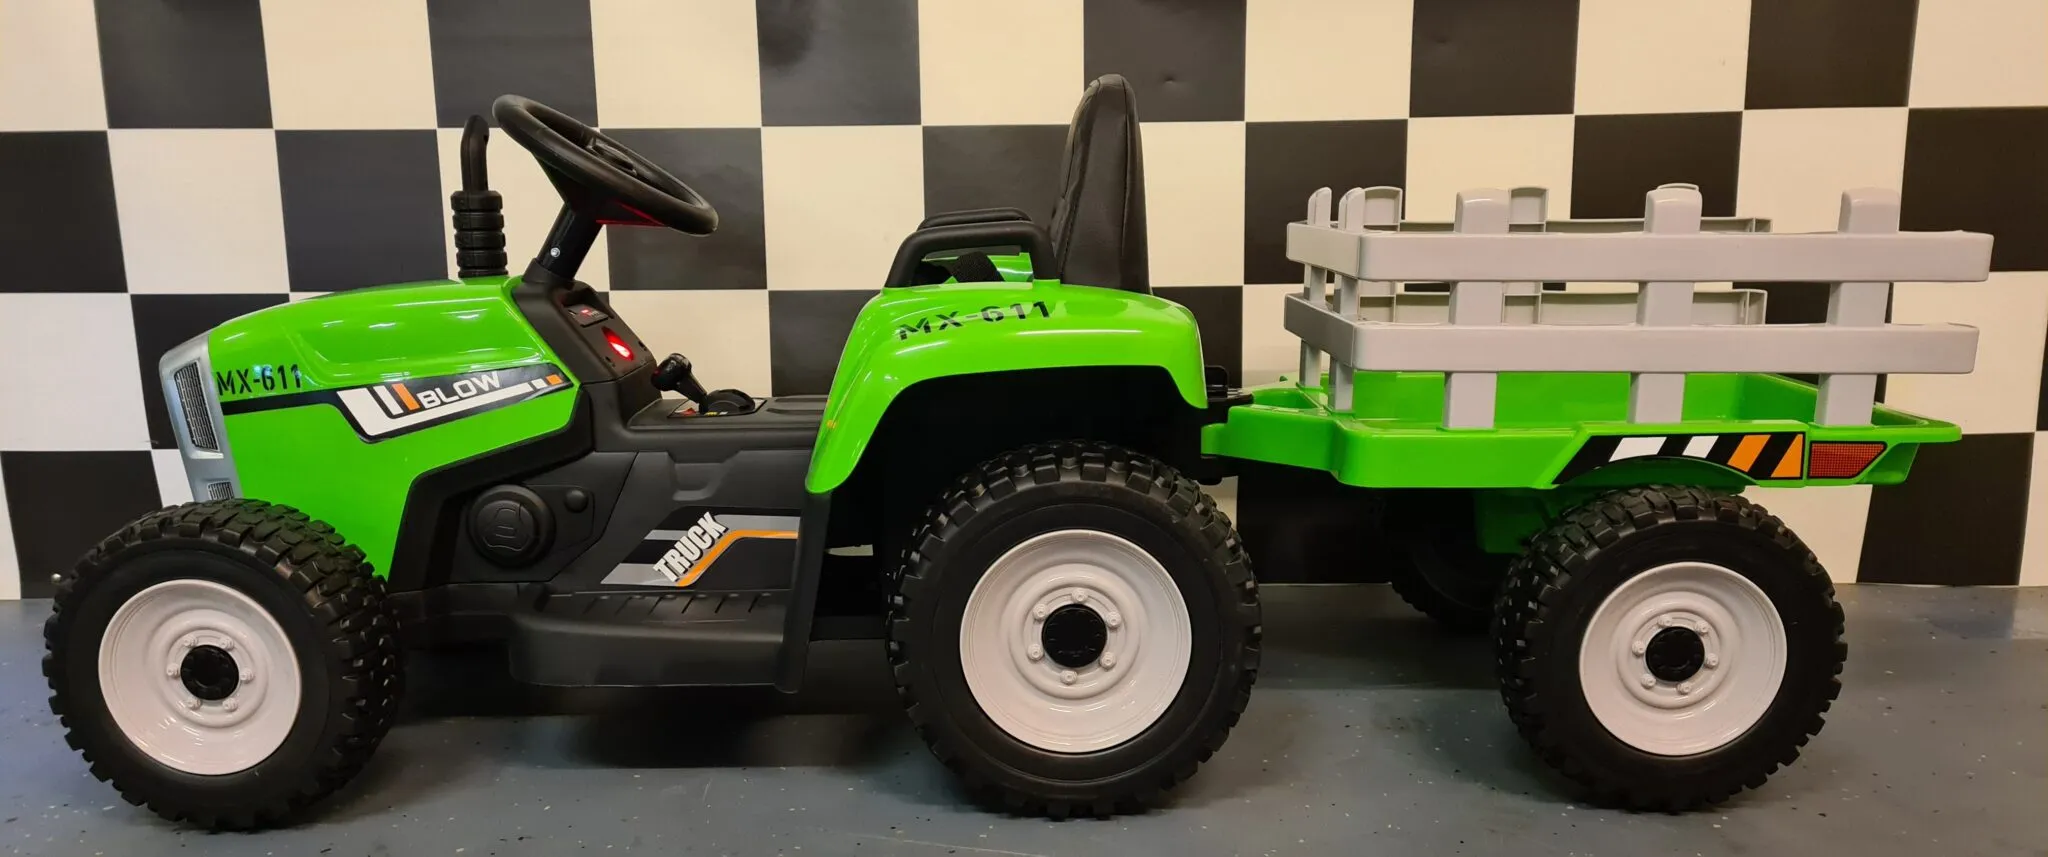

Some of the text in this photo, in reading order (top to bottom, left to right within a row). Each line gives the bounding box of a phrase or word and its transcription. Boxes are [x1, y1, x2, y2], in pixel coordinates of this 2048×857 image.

[897, 301, 1050, 341] MX-611
[216, 363, 303, 396] MX-611
[417, 370, 502, 410] BLOW
[652, 511, 728, 583] TRUCK
